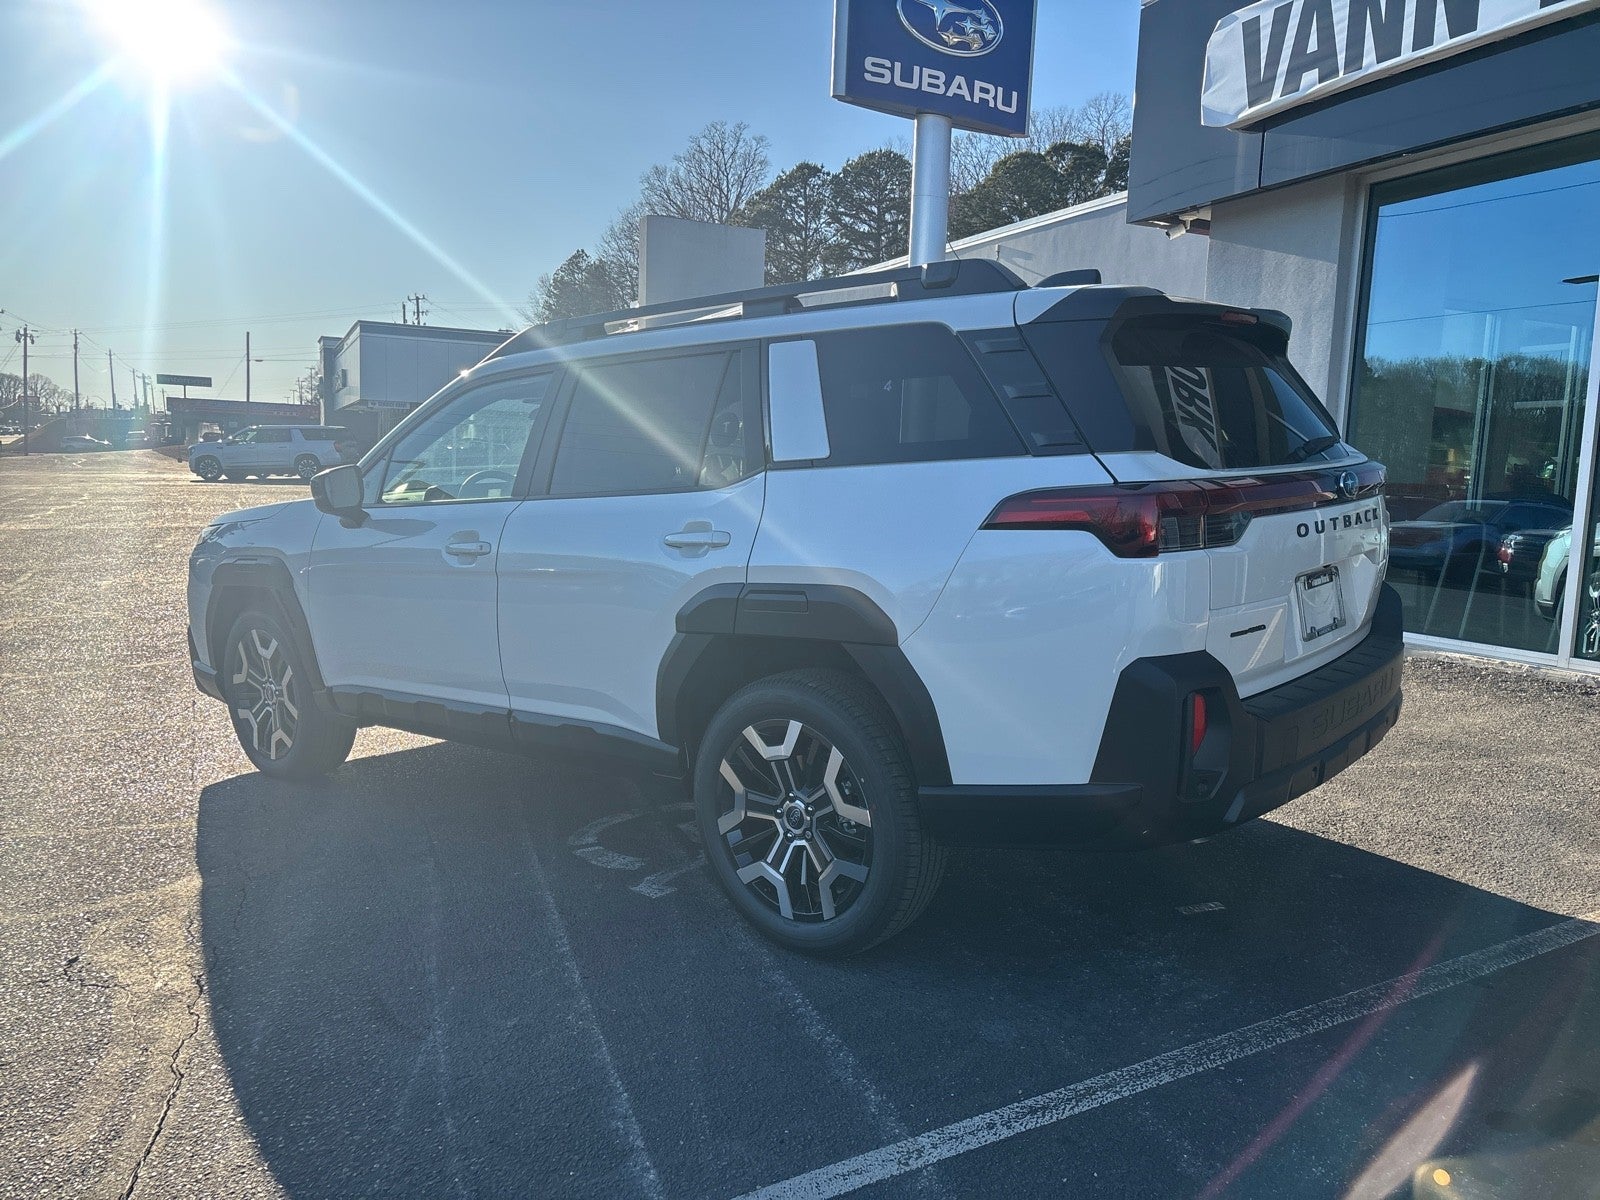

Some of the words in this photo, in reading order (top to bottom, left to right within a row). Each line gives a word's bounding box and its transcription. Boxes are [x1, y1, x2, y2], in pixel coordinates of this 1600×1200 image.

[863, 56, 1018, 114] SUBARU
[1296, 507, 1379, 538] OUTBACK
[1311, 667, 1395, 740] SUBARU
